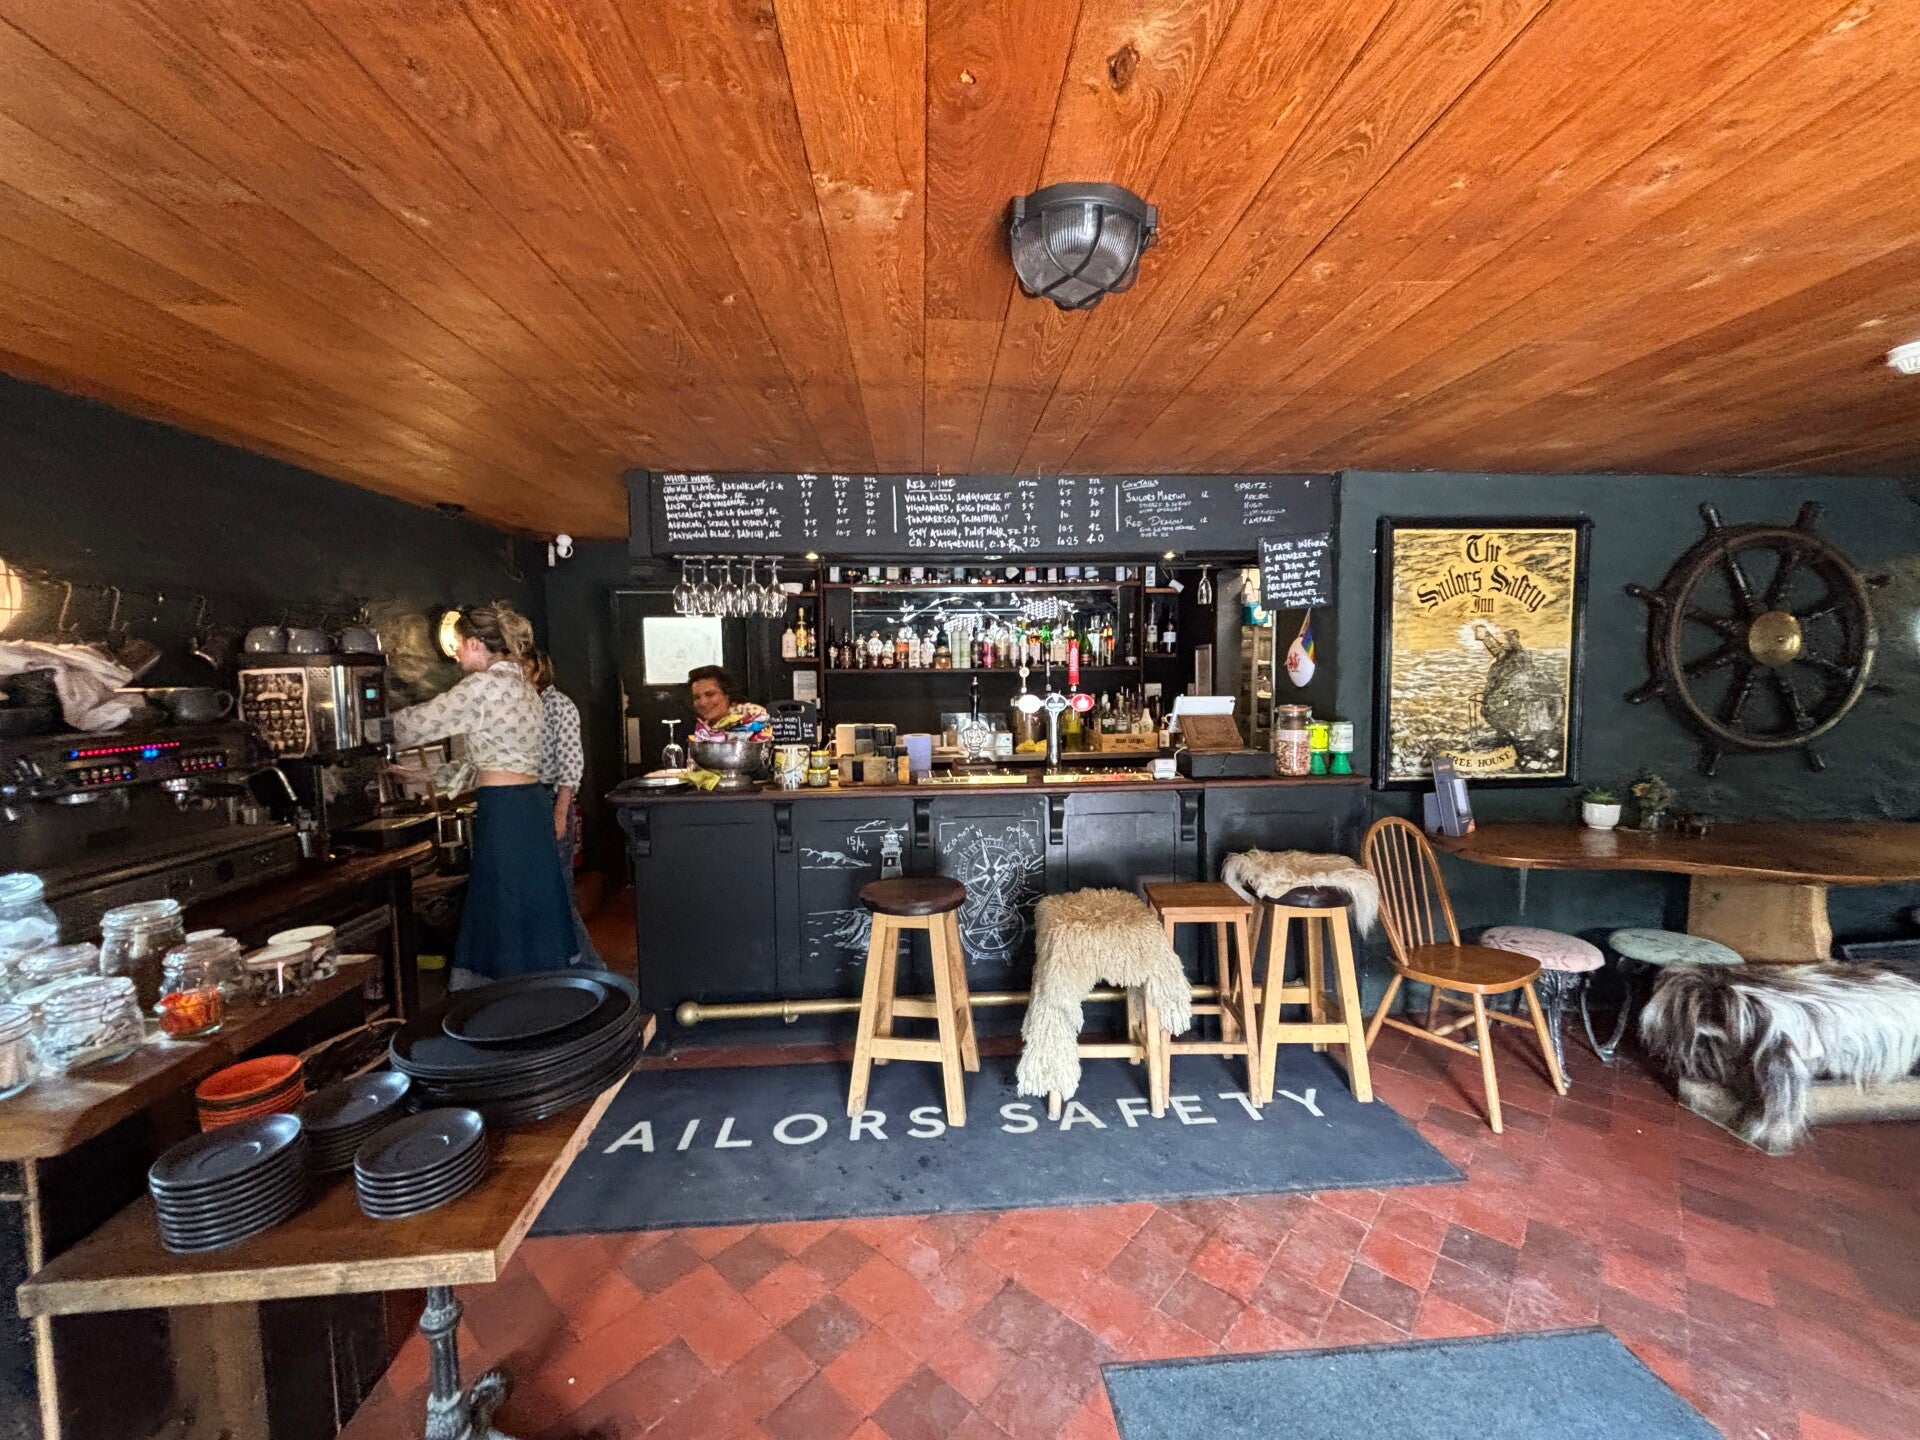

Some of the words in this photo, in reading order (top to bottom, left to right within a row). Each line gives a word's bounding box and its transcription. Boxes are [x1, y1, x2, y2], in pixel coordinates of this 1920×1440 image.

[907, 479, 926, 489] RED
[1157, 490, 1186, 501] MARTINI
[1201, 490, 1209, 498] 12
[1264, 541, 1294, 553] PLEASE
[1297, 538, 1329, 549] INFORM
[1466, 535, 1502, 564] The
[1275, 551, 1311, 561] MEMBER
[1265, 564, 1281, 573] OUR
[1283, 562, 1305, 571] TEAM
[1282, 572, 1303, 581] HAVE
[1304, 569, 1320, 578] ANY
[1416, 565, 1483, 613] Sailors
[1490, 564, 1547, 613] Safety
[1284, 597, 1311, 608] THANK
[1470, 594, 1494, 614] Inn
[1478, 750, 1513, 768] HOUSE
[602, 1106, 948, 1154] AILORS
[999, 1088, 1325, 1134] SAFETY
